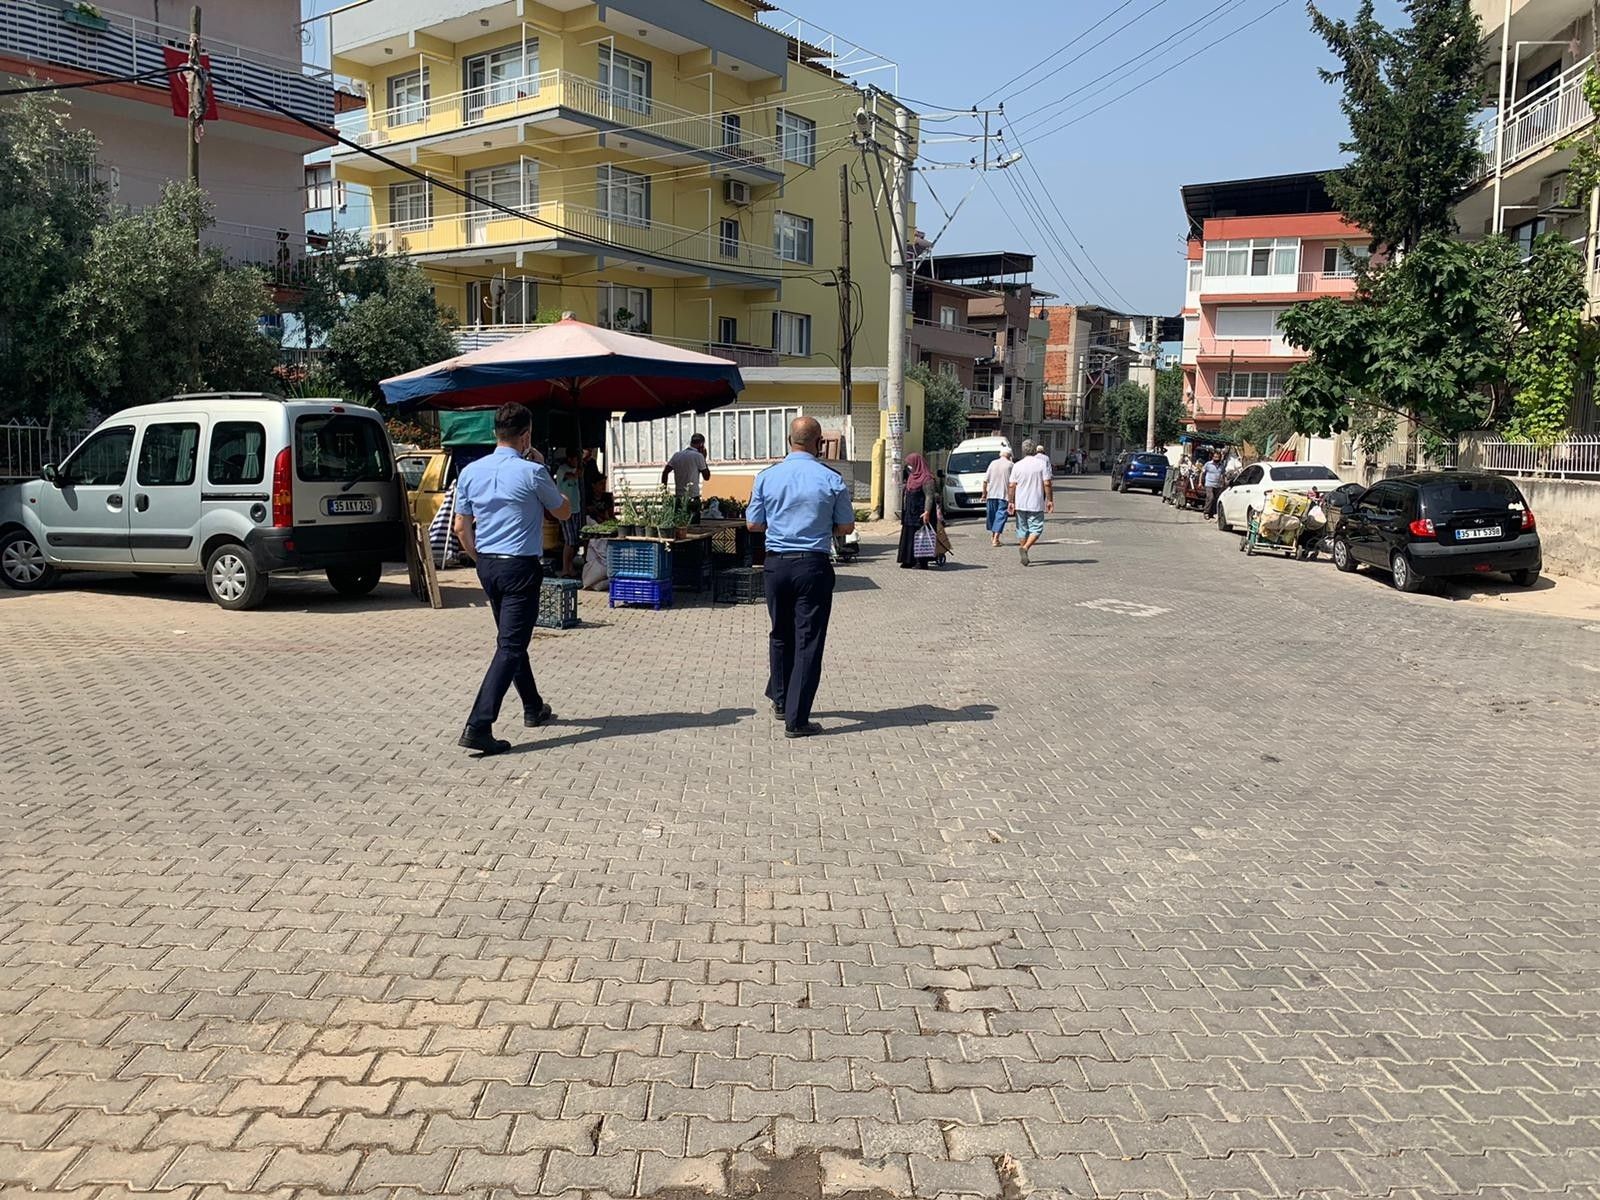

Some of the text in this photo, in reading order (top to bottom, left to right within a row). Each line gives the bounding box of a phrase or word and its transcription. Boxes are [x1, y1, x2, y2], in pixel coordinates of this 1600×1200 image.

[334, 501, 371, 511] 35 AKY 249
[1461, 530, 1470, 538] 35
